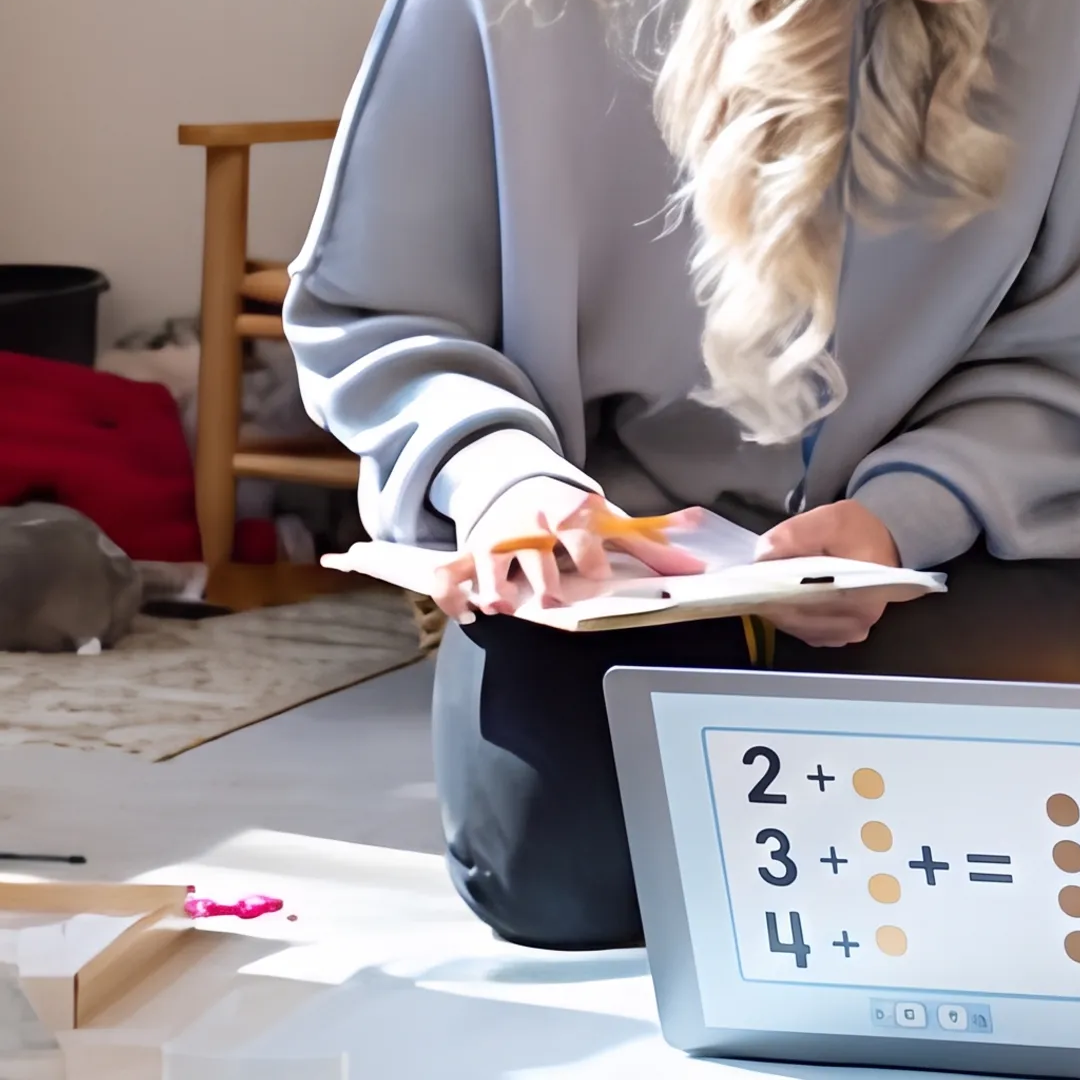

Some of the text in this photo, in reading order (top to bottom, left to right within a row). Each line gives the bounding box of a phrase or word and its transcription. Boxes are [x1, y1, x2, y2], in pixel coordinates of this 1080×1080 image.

[742, 745, 788, 805] 2
[755, 827, 798, 887] 3
[765, 911, 811, 969] 4
